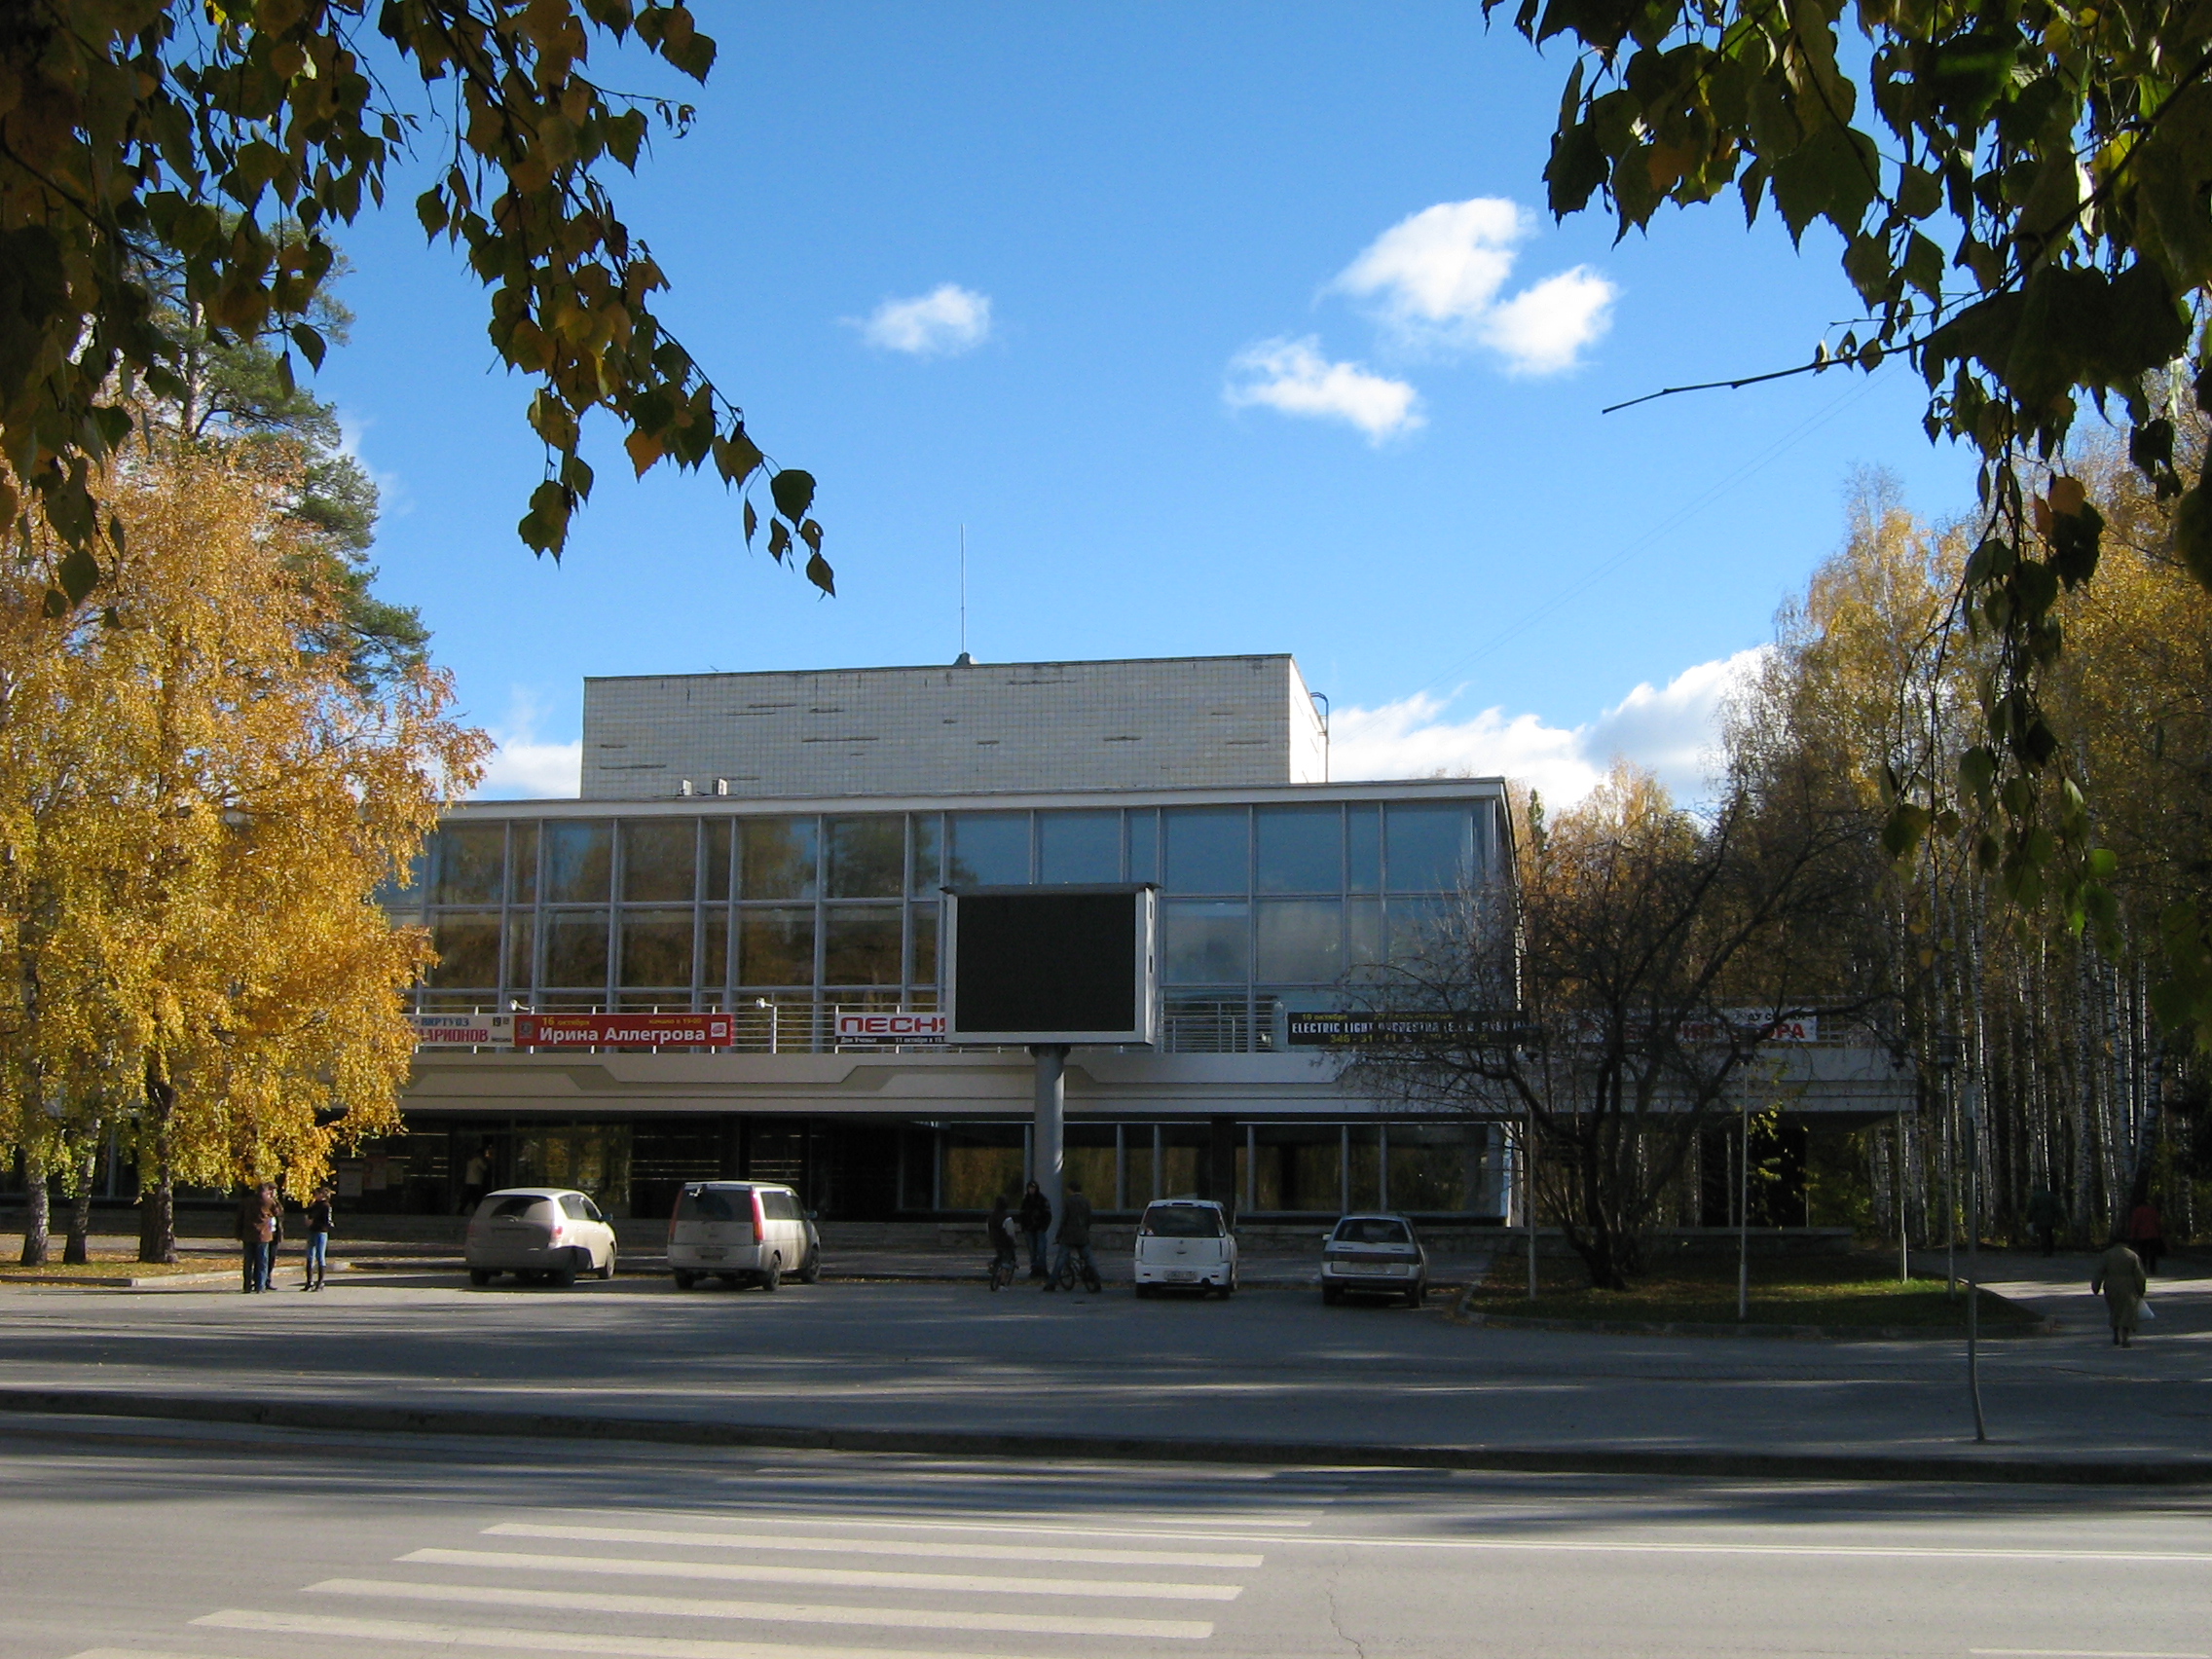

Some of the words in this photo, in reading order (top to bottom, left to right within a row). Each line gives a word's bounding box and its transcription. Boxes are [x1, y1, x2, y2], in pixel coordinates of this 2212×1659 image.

[541, 1016, 555, 1025] 16
[840, 1016, 945, 1033] ПЕСН
[1291, 1022, 1342, 1033] ELECTRIC
[1344, 1022, 1374, 1033] LIGHT
[539, 1027, 599, 1045] Ирина
[604, 1027, 706, 1045] Аллегрова
